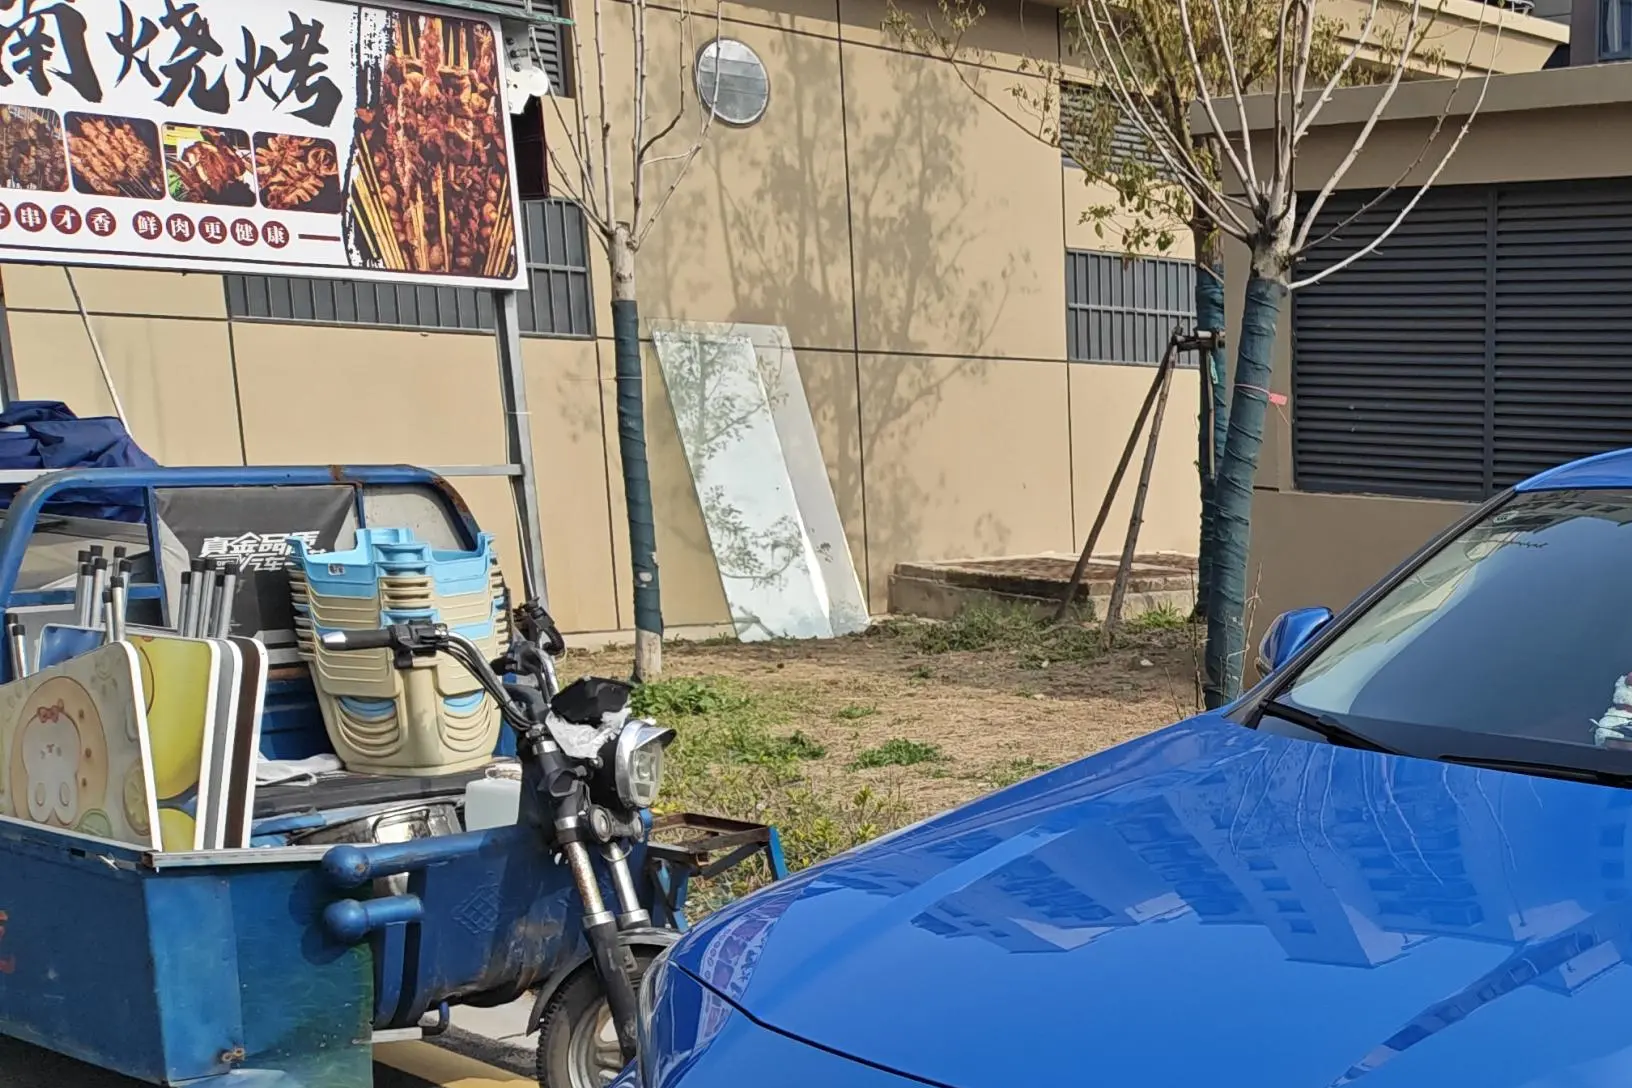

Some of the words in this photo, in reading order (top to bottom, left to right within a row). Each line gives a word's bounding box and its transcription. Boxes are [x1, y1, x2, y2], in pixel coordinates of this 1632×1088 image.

[0, 0, 343, 128] 南烧烤
[134, 213, 287, 246] 鲜肉更健康
